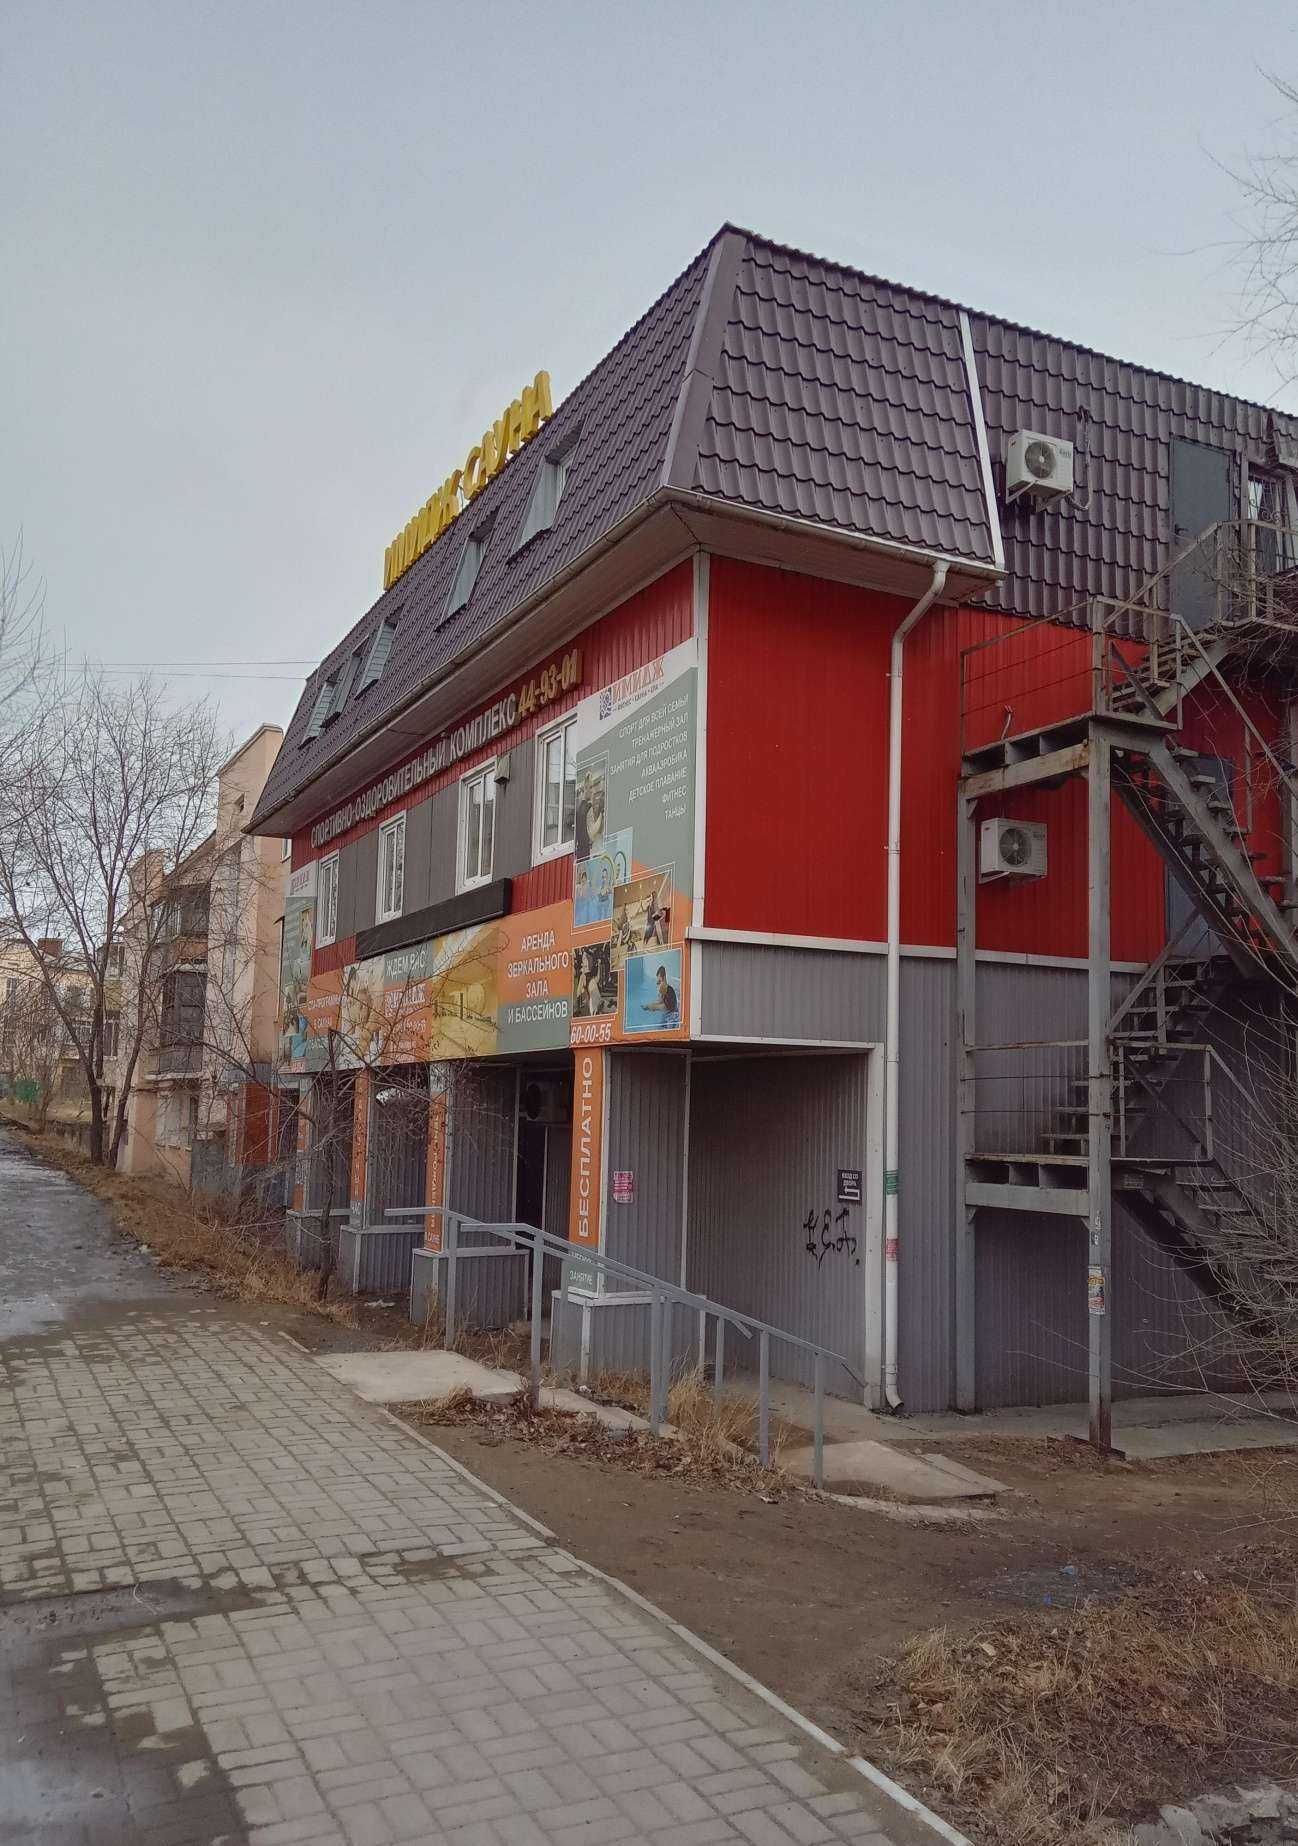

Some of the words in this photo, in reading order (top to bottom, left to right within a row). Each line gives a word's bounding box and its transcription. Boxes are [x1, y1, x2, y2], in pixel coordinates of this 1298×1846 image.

[463, 370, 553, 500] САУНА
[618, 720, 638, 738] СПОРТ
[638, 718, 650, 734] ДЛЯ
[650, 708, 667, 727] ВСЕЙ
[667, 694, 689, 717] СЕМЬИ
[632, 719, 676, 748] ТРЕНАЖЕРНЫЙ
[675, 712, 689, 728] ЗАЛ
[311, 735, 449, 848] СПОРТИВНО-ОЗДОРОВИТЕЛЬНЫЙ
[450, 693, 516, 761] КОМПЛЕКС
[517, 650, 583, 720] 44-93-01
[610, 756, 636, 776] ЗАНЯТИЯ
[636, 752, 648, 767] ДЛЯ
[649, 731, 688, 757] ПОДРОСТКОВ
[629, 782, 655, 804] ДЕТСКОЕ
[655, 768, 687, 791] ПЛАВАНИЕ
[662, 785, 687, 803] ФИТНЕС
[664, 805, 687, 820] ТАНЦЫ
[520, 930, 556, 952] АРЕНДА
[386, 956, 409, 981] ЖДЕМ
[410, 951, 426, 972] ВАС
[507, 952, 569, 978] ЗЕРКАЛЬНОГО
[525, 979, 549, 999] ЗАЛА
[508, 1011, 514, 1024] И
[515, 999, 568, 1023] БАССЕЙНОВ
[570, 1023, 611, 1044] 60-00-55
[578, 1057, 593, 1238] БЕСПЛАТНО
